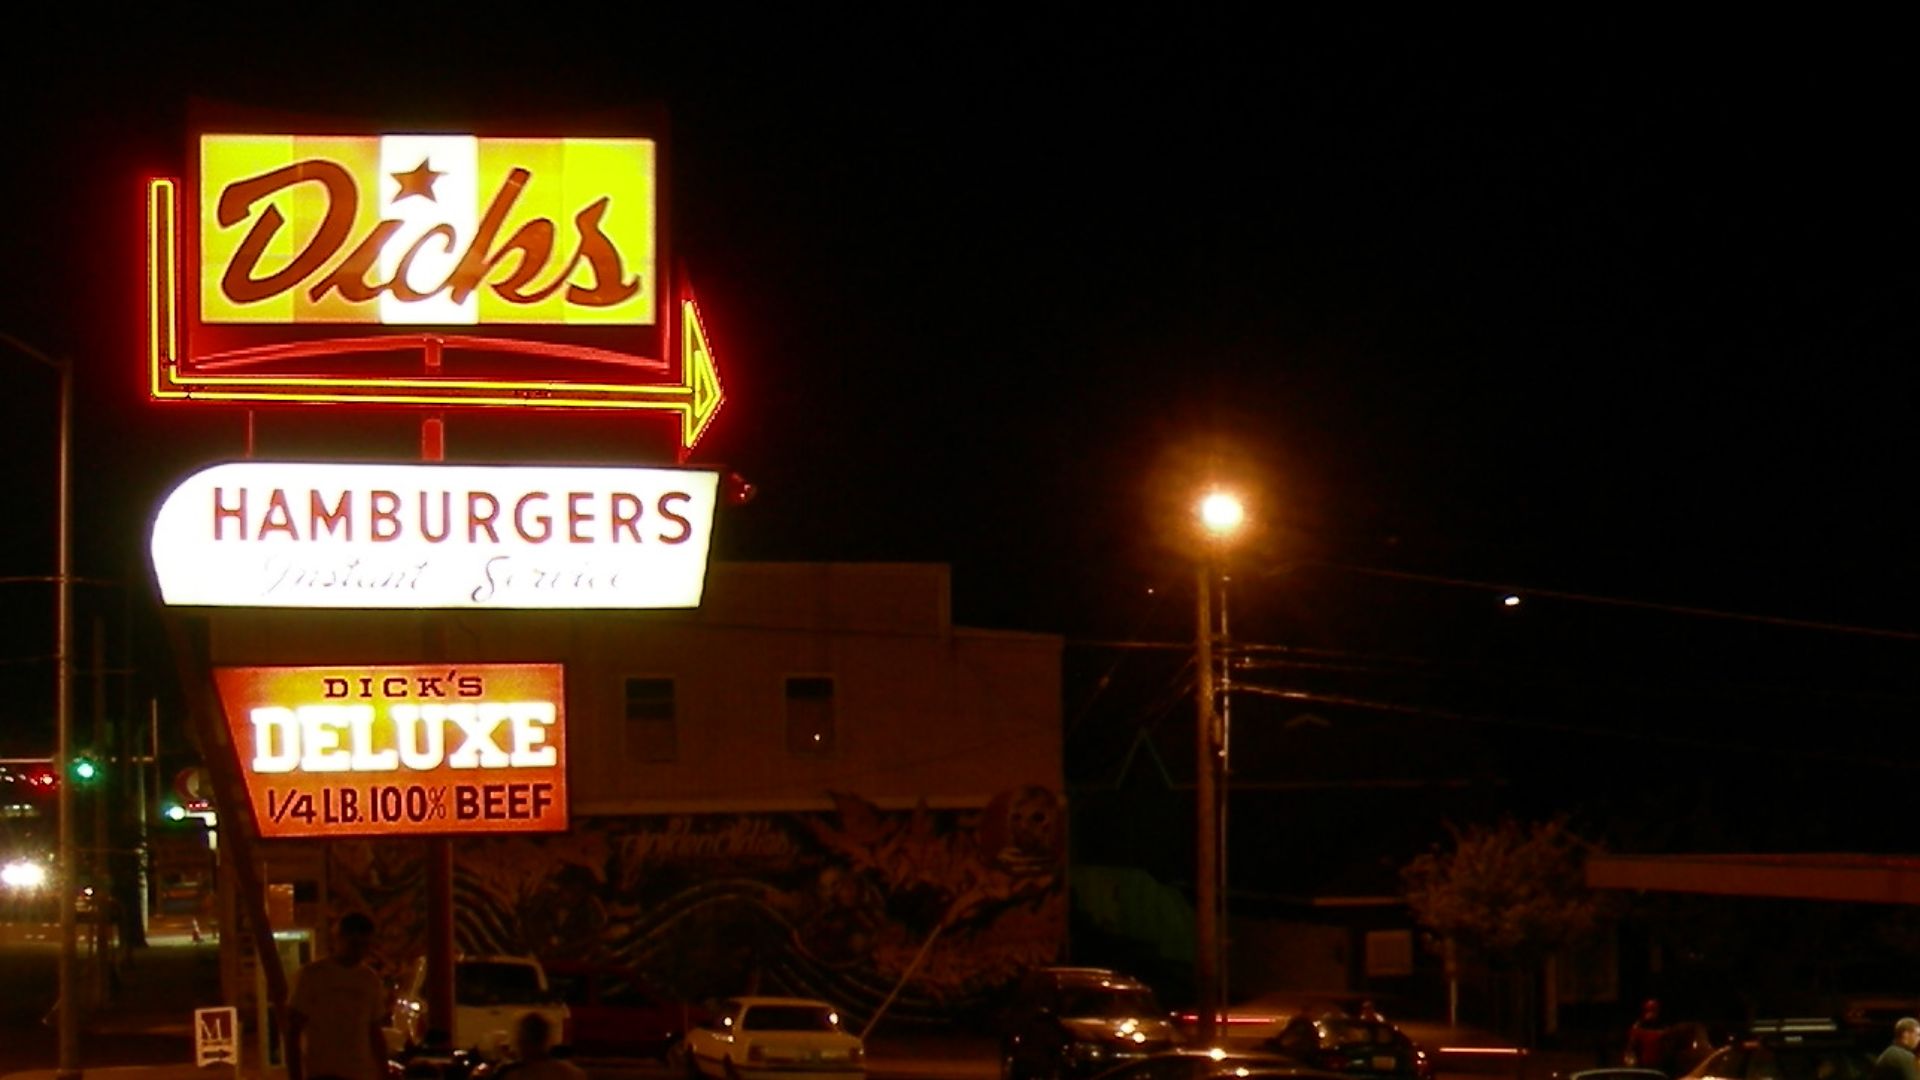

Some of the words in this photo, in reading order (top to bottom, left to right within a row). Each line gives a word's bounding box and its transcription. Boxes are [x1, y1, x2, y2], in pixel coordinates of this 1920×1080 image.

[213, 487, 693, 545] HAMBURGERS
[323, 670, 483, 698] DICK'S
[250, 702, 557, 772] DELUXE
[268, 789, 316, 823] 1/4
[323, 788, 363, 823] LB.
[371, 785, 447, 822] 100%
[455, 783, 553, 820] BEEF
